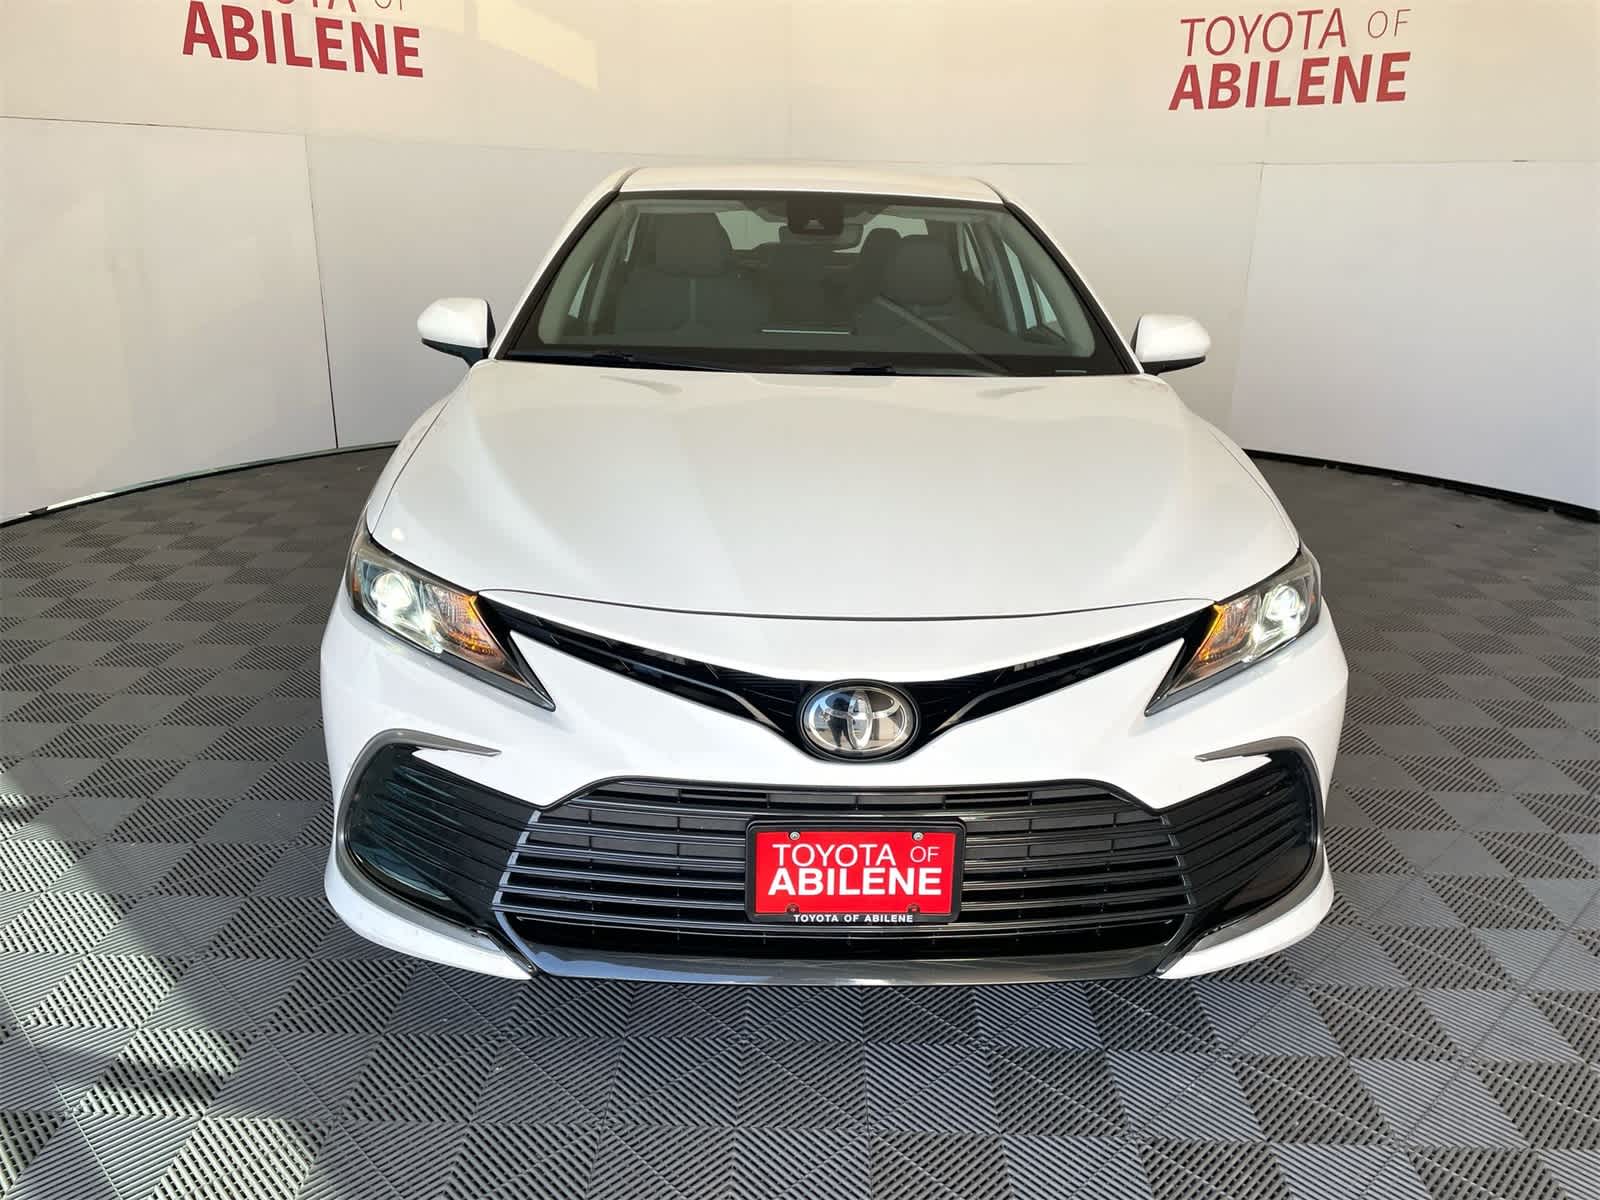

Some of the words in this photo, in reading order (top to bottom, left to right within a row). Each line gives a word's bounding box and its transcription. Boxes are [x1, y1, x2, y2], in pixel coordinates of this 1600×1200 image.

[182, 1, 424, 78] ABILENE
[1180, 7, 1348, 57] TOYOTA
[1367, 8, 1412, 39] OF
[1168, 51, 1411, 111] ABILENE
[772, 843, 897, 868] TOYOTA
[909, 846, 940, 863] OF
[767, 867, 943, 896] ABILENE
[793, 914, 839, 923] TOYOTA
[843, 914, 860, 923] OF
[863, 914, 914, 923] ABILENE
